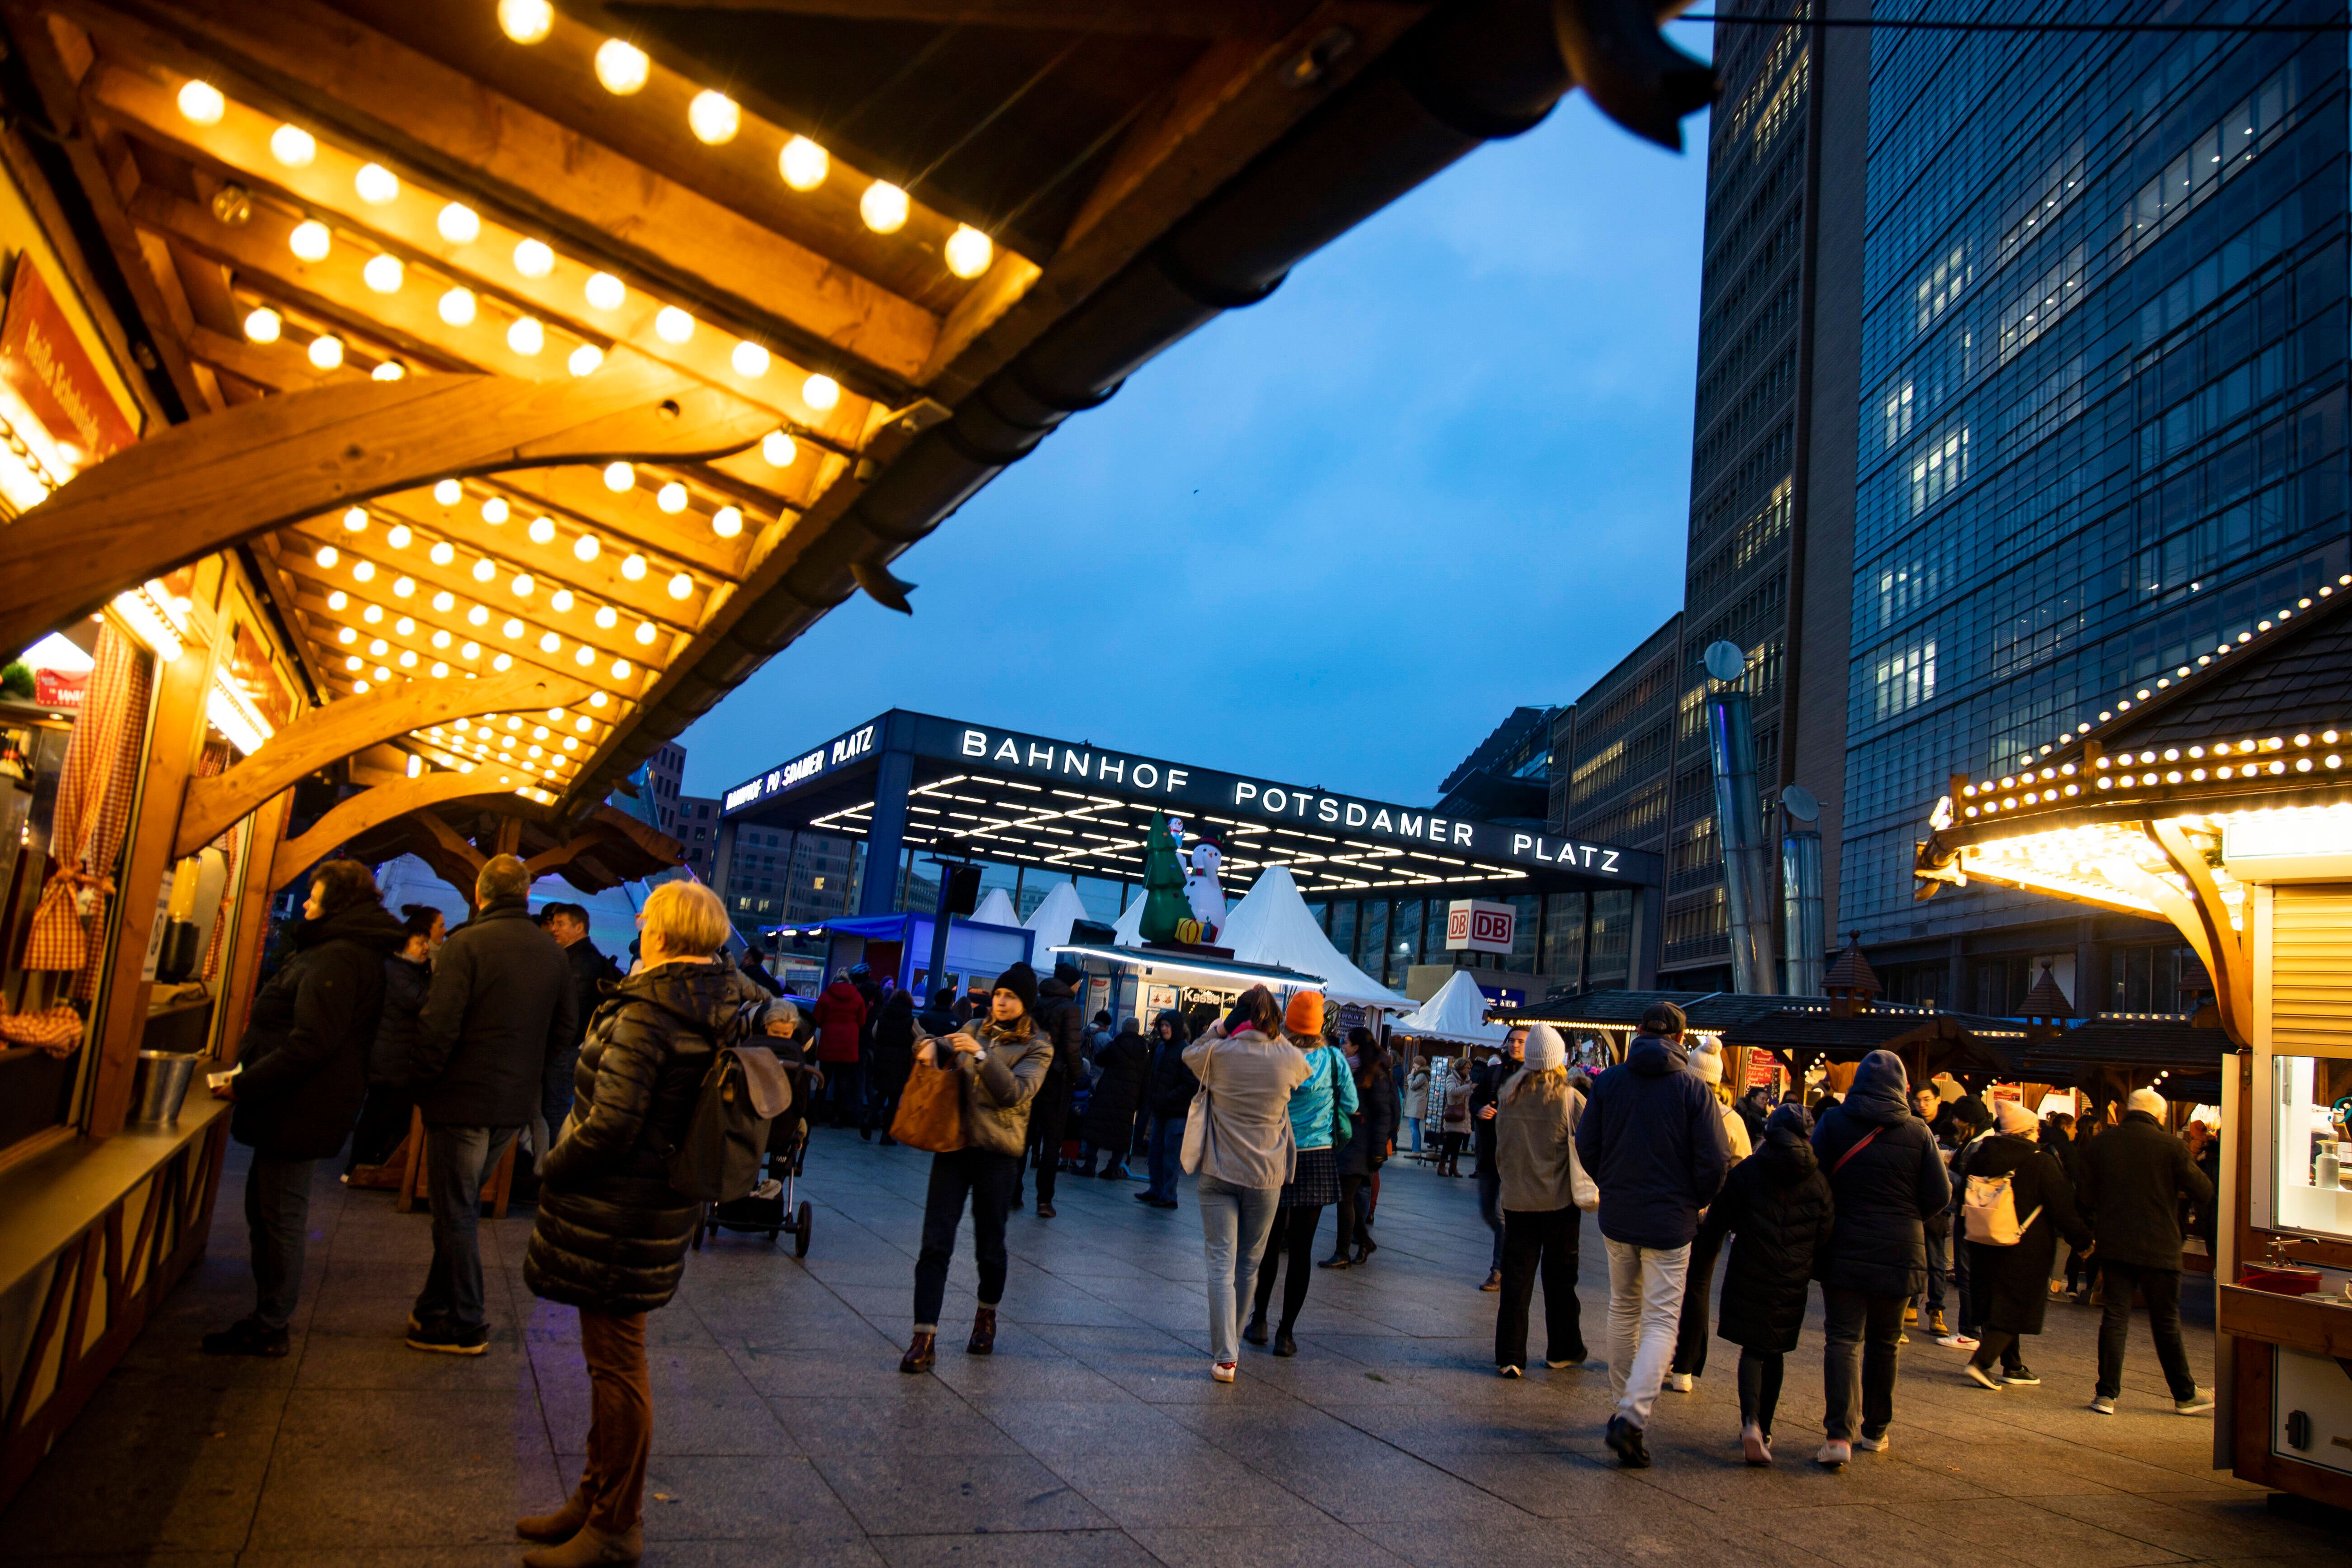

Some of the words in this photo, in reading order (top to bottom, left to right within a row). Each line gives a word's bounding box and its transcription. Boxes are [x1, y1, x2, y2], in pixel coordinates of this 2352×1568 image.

[725, 778, 763, 810] BAHNHOF
[831, 725, 874, 765] PLATZ
[962, 730, 1189, 792] BAHNHOF
[1235, 782, 1473, 847] POTSDAMER
[1513, 834, 1620, 873] PLATZ
[1451, 914, 1466, 935] DB
[1477, 915, 1507, 938] DB
[1184, 989, 1220, 1005] Kasse
